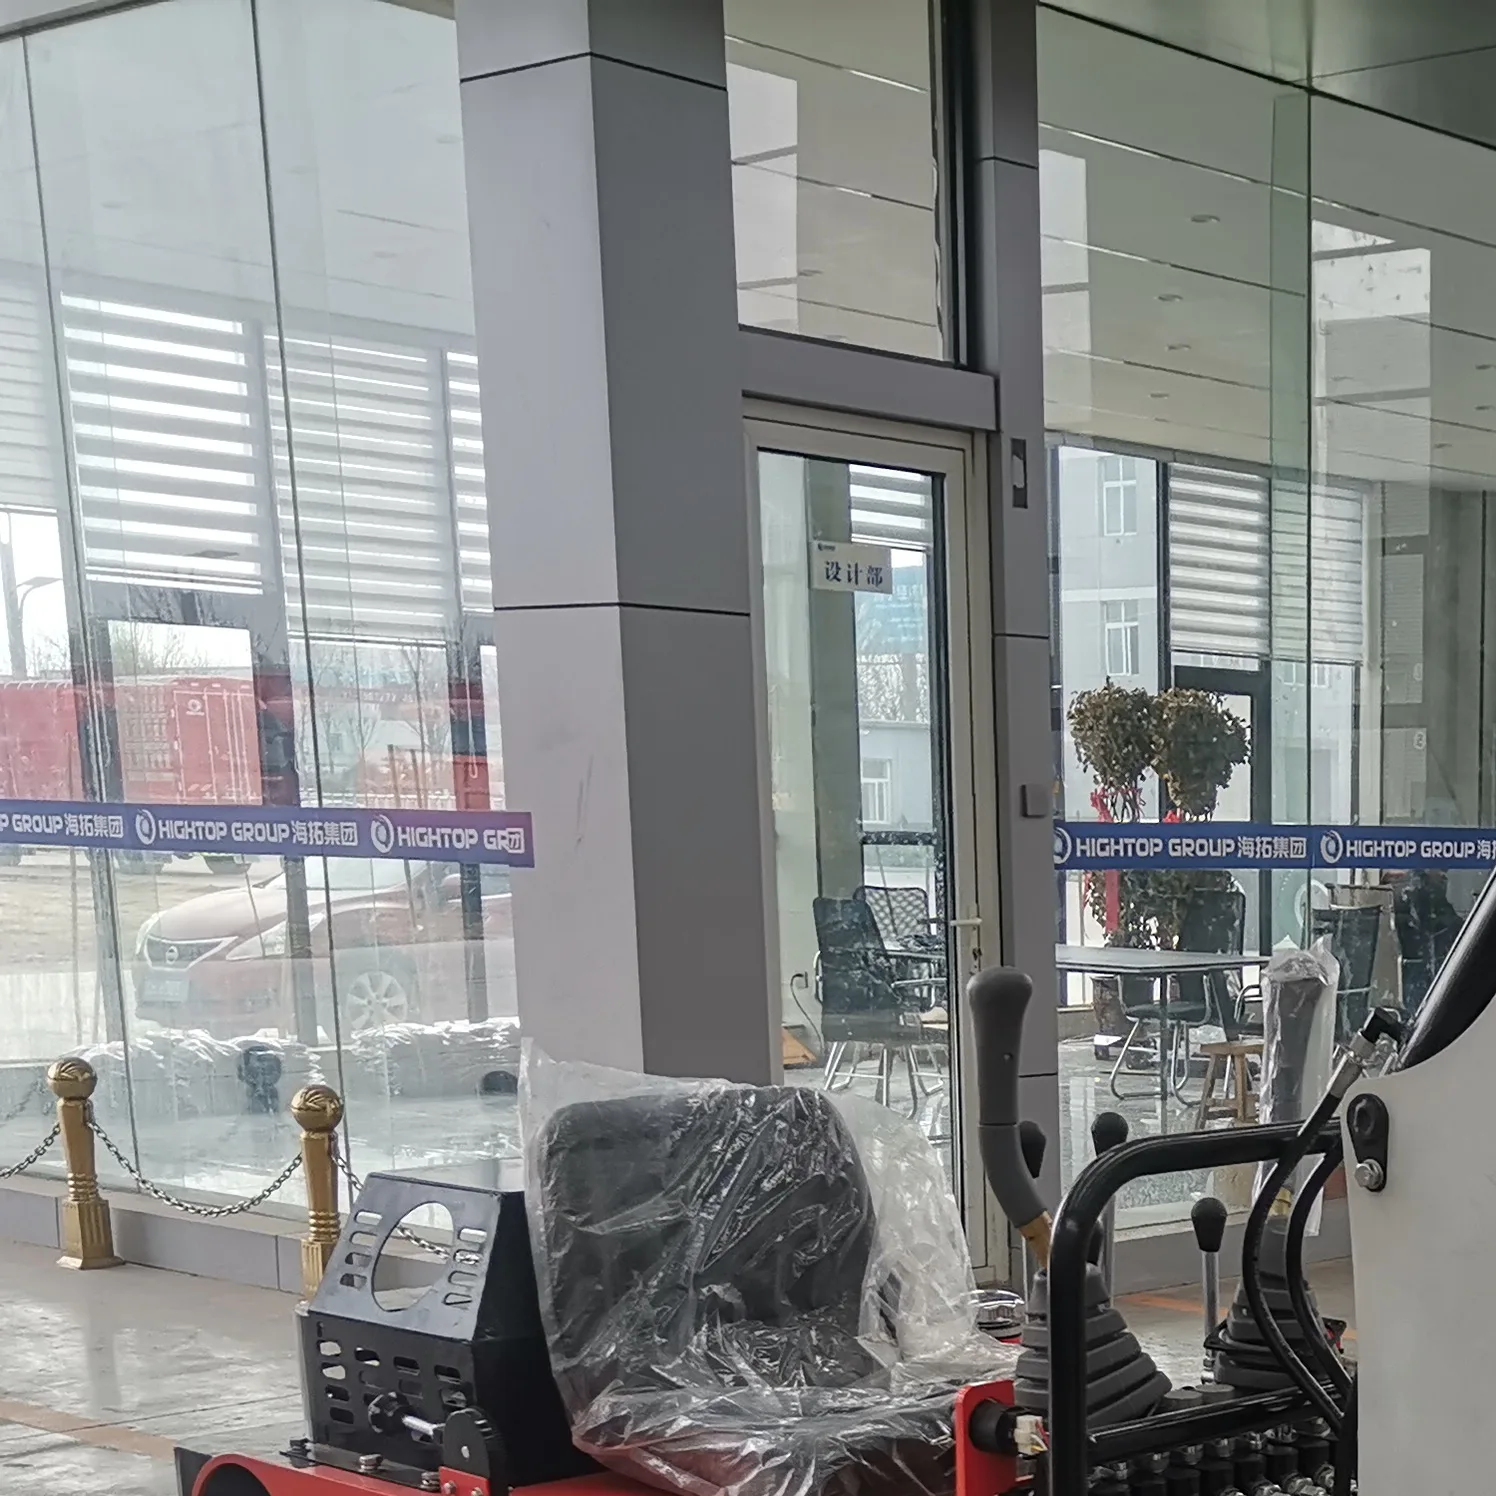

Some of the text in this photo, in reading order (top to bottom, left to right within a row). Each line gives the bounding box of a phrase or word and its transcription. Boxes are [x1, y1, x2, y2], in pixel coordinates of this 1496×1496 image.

[825, 561, 883, 587] 设计部
[12, 814, 63, 834] GROUP
[65, 812, 124, 838] 海拓集团
[158, 819, 358, 846] HIGHTOP GROUP 海拓集团
[397, 826, 478, 849] HIGHTOP
[1075, 836, 1307, 859] HIGHTOP GROUP 海拓集团
[1346, 839, 1417, 858] HIGHTOP
[1421, 840, 1476, 859] GROUP
